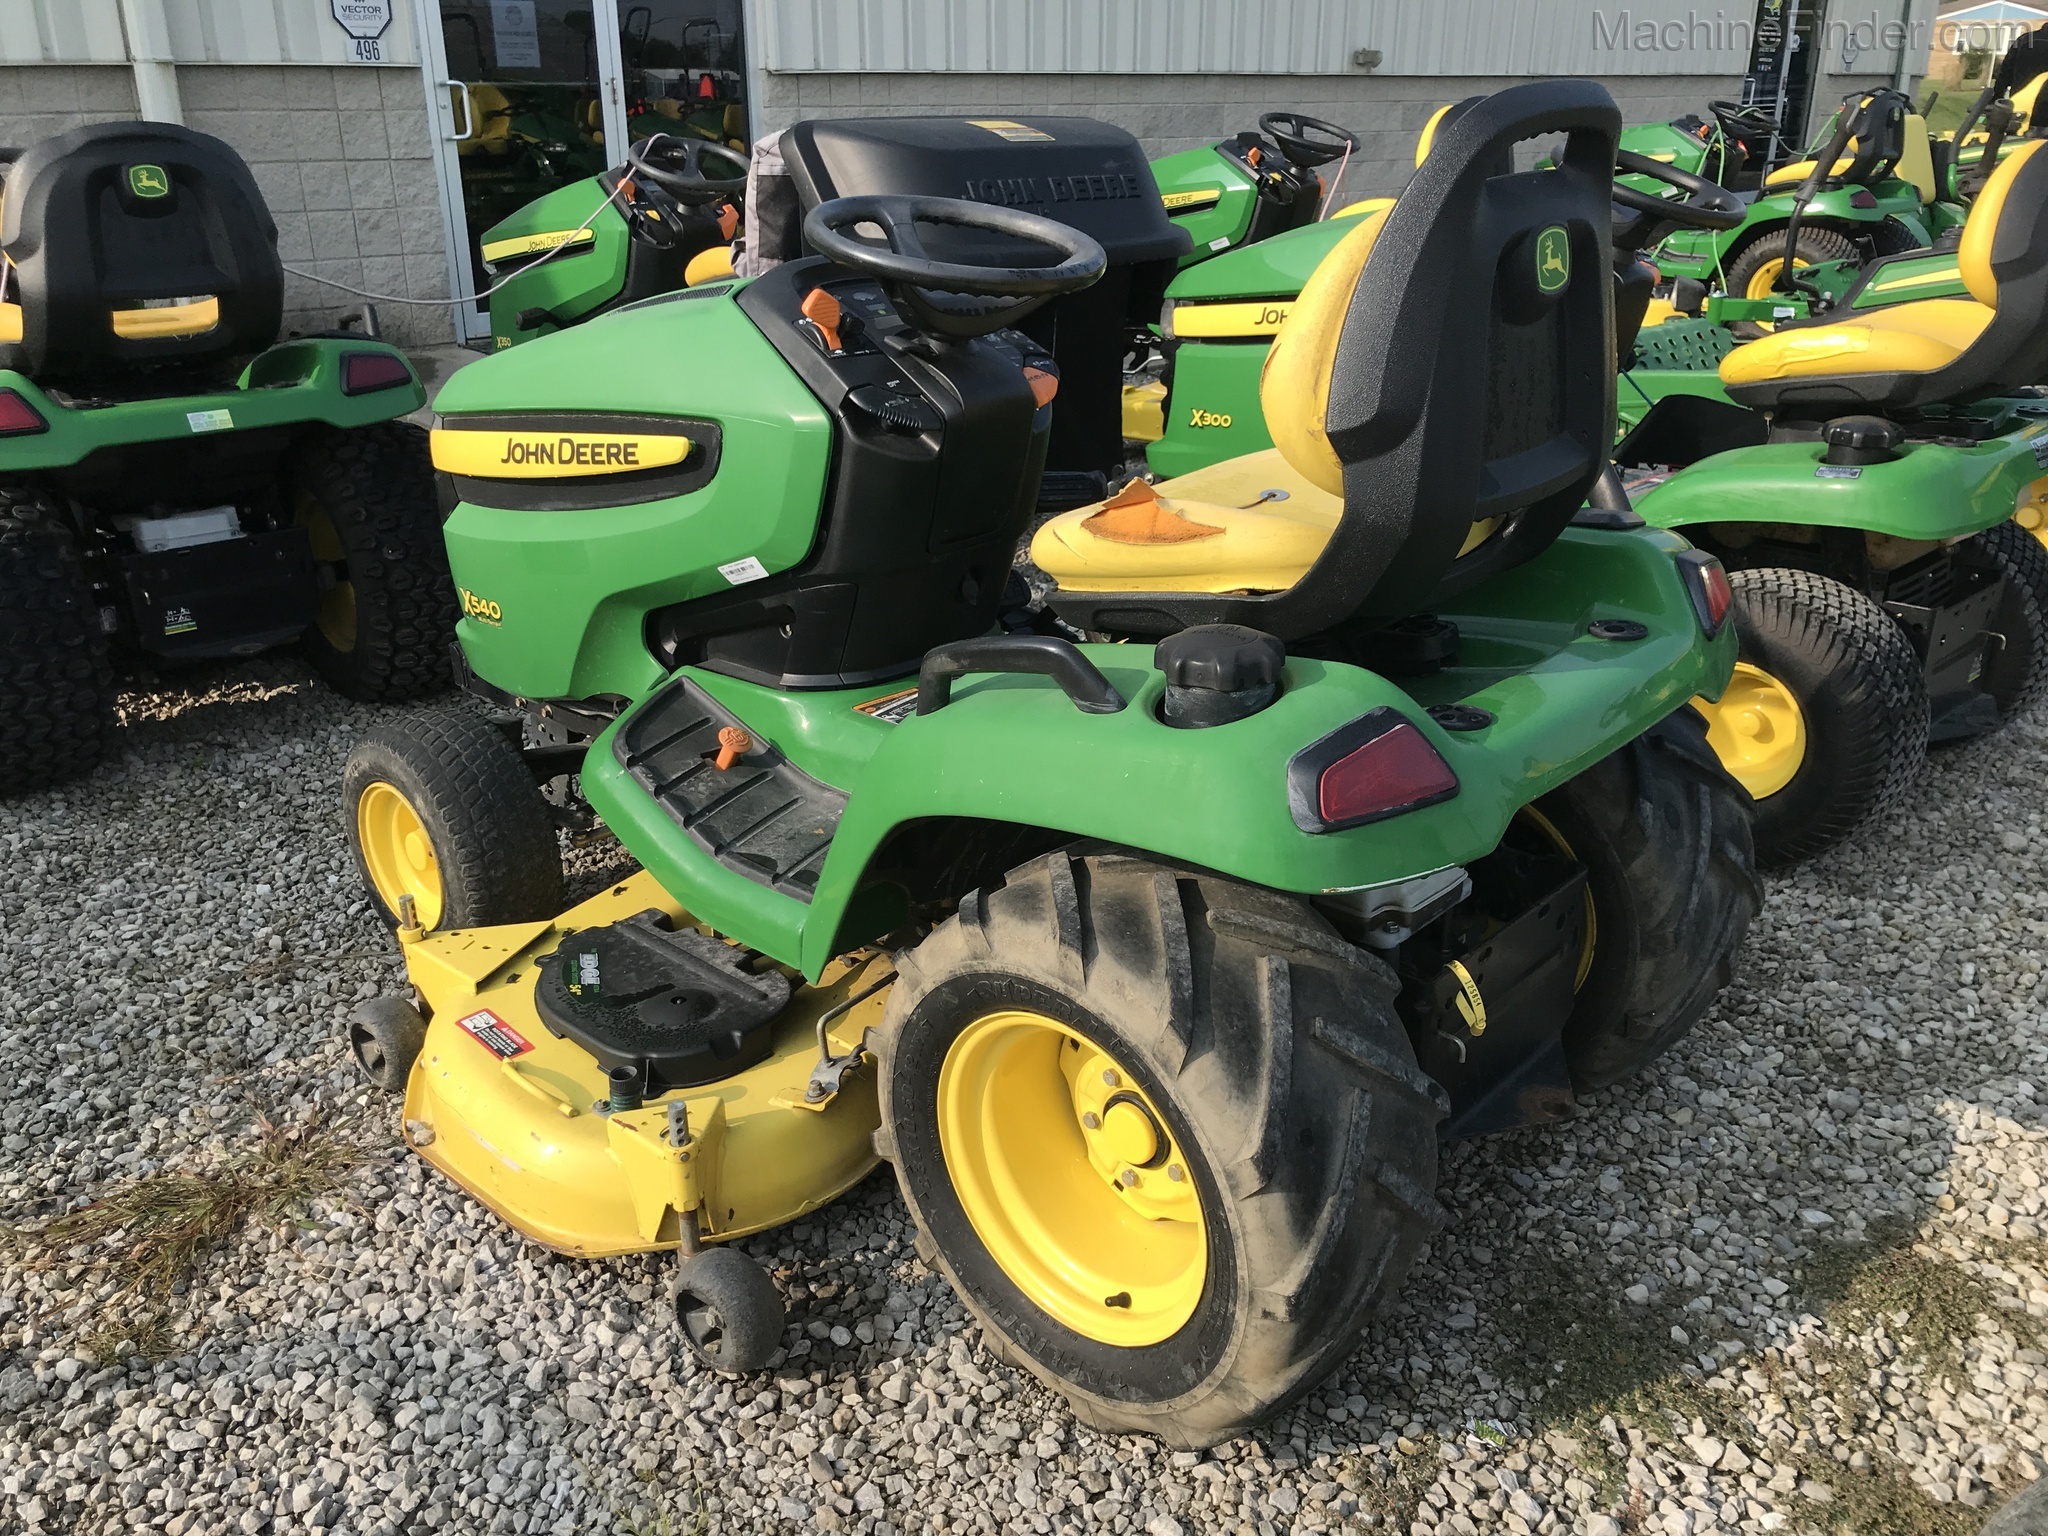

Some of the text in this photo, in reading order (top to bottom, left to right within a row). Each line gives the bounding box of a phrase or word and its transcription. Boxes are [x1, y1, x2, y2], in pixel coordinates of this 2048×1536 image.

[340, 5, 382, 14] VECTOR
[342, 13, 383, 21] SECURITY
[356, 40, 381, 61] 496
[961, 173, 1141, 205] JOHN DEERE
[1163, 194, 1194, 206] DEERE
[528, 239, 546, 251] JOHN
[496, 336, 512, 348] X350
[1189, 408, 1232, 428] X300
[501, 438, 640, 465] JOHN DEERE
[459, 586, 502, 620] X540
[579, 952, 600, 986] EDGE
